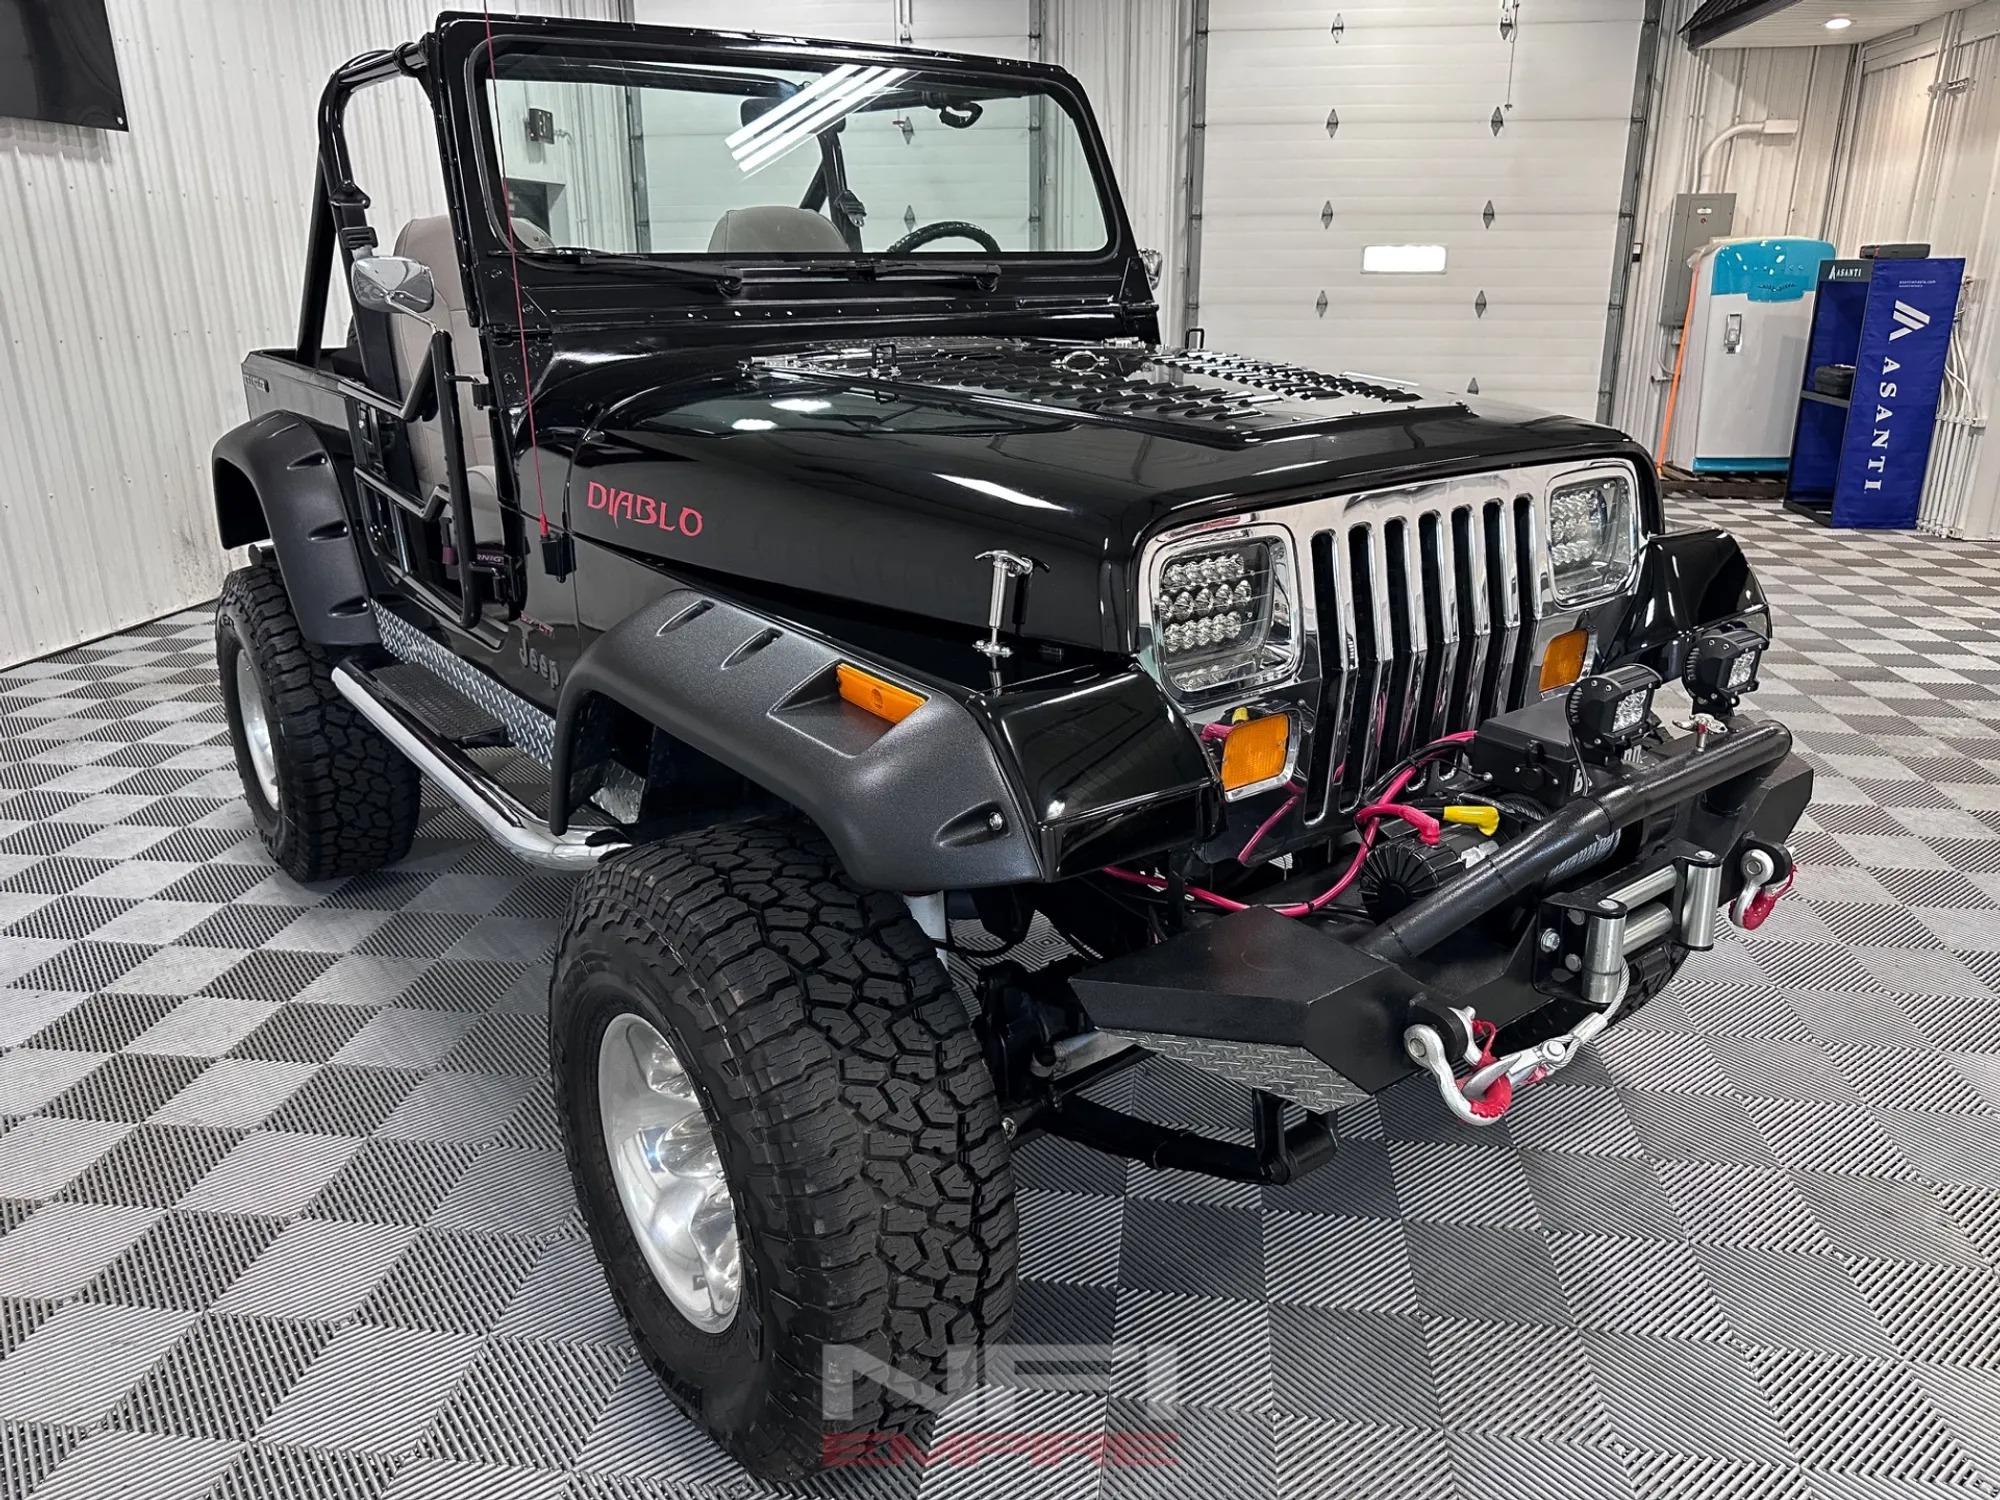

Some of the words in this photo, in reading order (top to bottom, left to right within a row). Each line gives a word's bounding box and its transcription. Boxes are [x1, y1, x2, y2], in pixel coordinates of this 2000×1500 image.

[1836, 268, 1862, 277] ASANTI
[1863, 356, 1901, 492] ASANTI
[587, 481, 704, 537] DIABLO
[519, 640, 560, 689] Jeep
